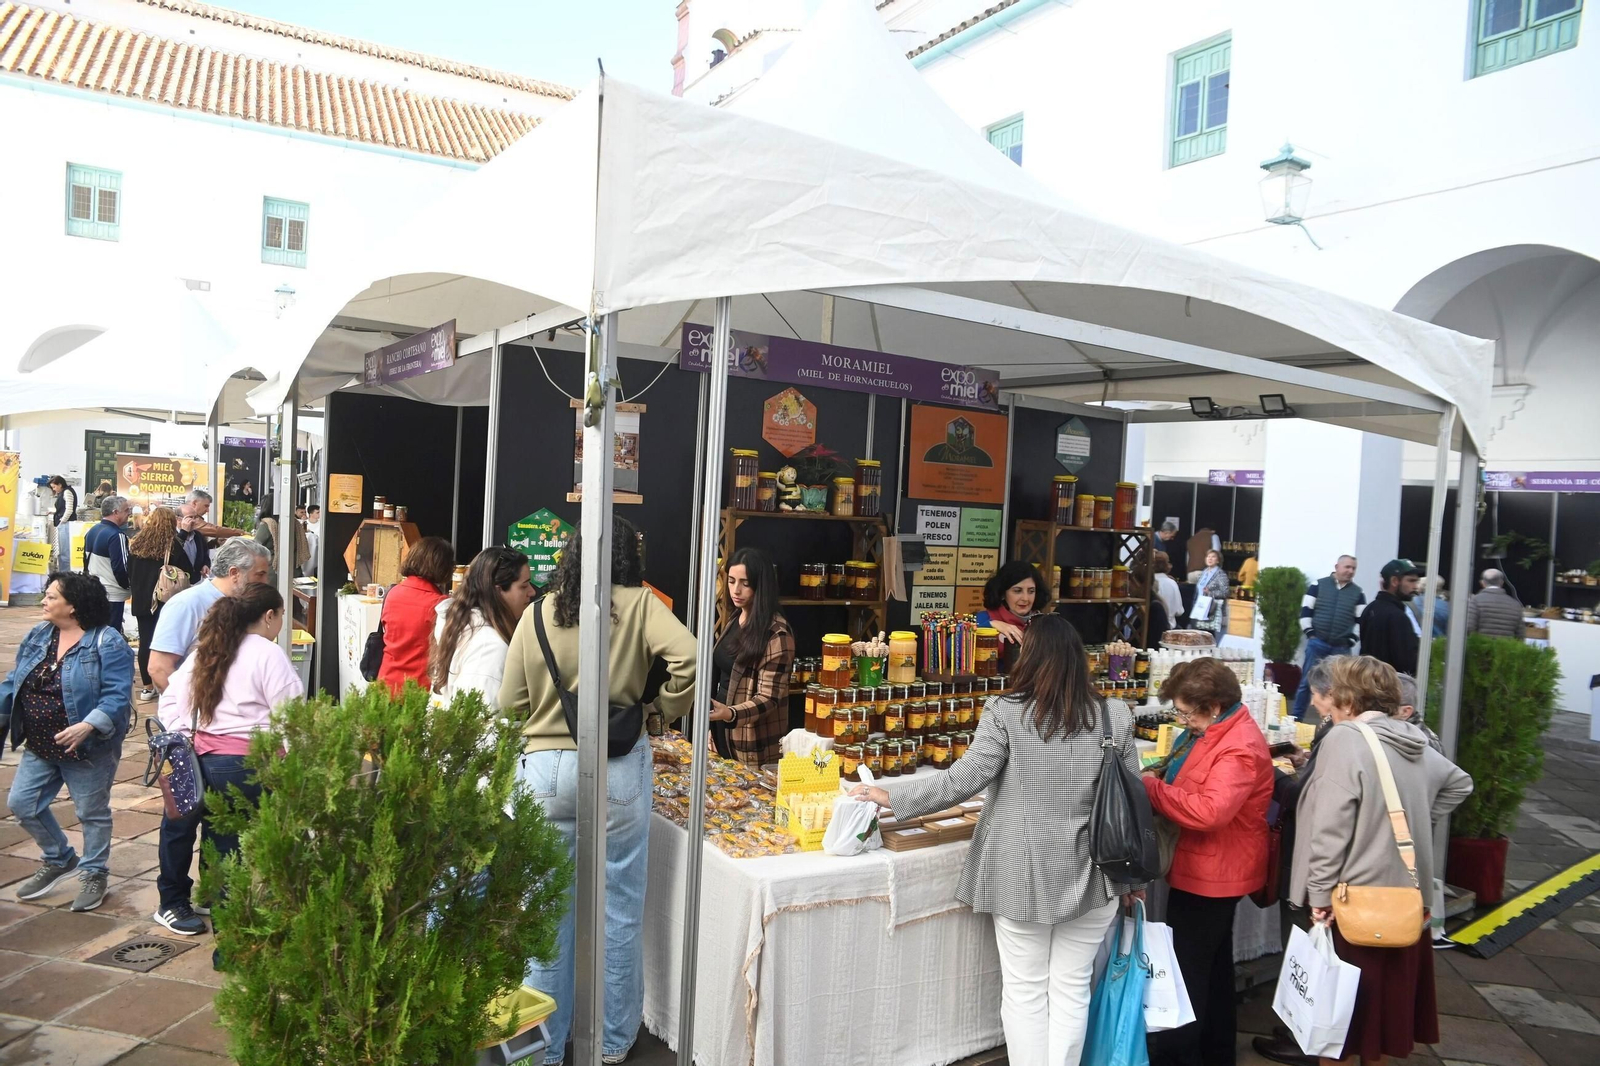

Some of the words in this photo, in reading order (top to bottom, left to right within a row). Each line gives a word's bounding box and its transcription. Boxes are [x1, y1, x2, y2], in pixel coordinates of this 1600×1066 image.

[386, 350, 402, 365] RANCHO
[402, 341, 427, 360] CORTESANO
[700, 348, 740, 367] mel
[821, 353, 894, 375] MORAMIEL
[797, 368, 825, 379] (MIEL
[828, 372, 841, 381] DE
[843, 374, 913, 392] HORNACHUELOS)
[941, 367, 976, 386] expo
[950, 382, 979, 399] miel
[152, 462, 175, 472] MIEL
[140, 472, 175, 482] SIERRA
[1531, 477, 1573, 485] SERRANÍA
[140, 483, 186, 494] MONTORO
[920, 509, 957, 518] TENEMOS
[925, 521, 951, 529] POLEN
[22, 551, 44, 559] zukán
[1289, 973, 1309, 999] miel
